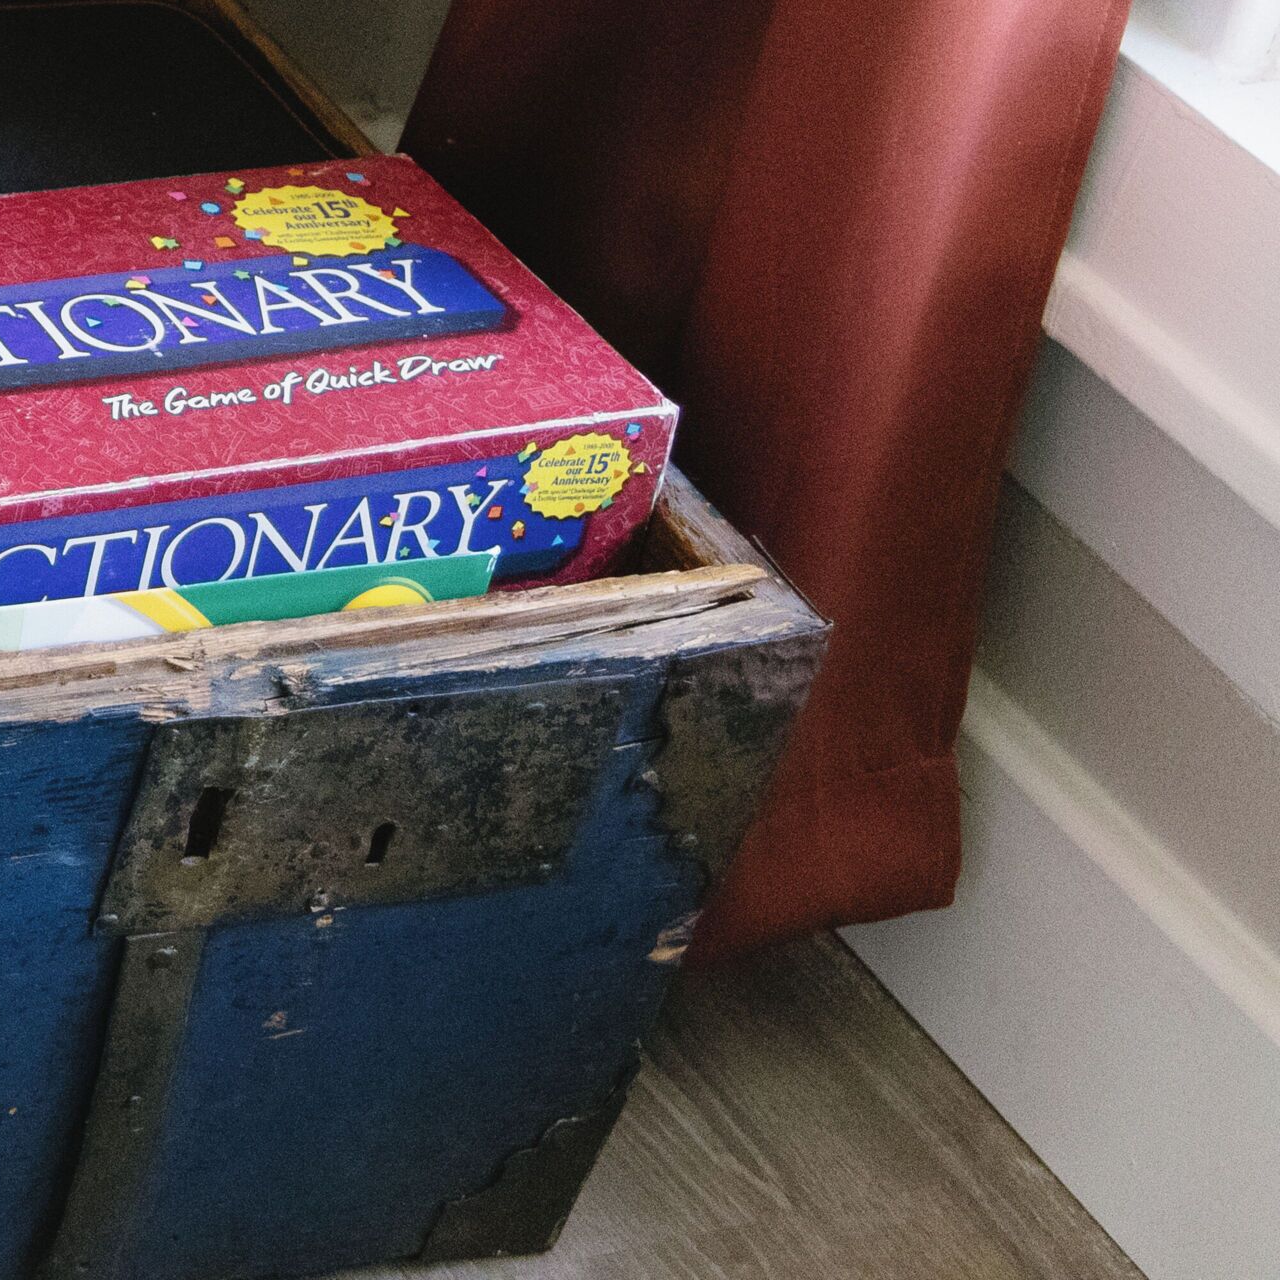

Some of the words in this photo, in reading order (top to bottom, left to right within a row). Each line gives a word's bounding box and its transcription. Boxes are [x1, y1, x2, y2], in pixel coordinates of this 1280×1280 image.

[241, 205, 311, 217] Celebrate
[285, 219, 371, 231] Anniversary
[102, 392, 160, 421] The
[163, 386, 257, 416] Game
[262, 371, 301, 404] of
[305, 363, 398, 396] Quick
[400, 354, 498, 381] Draw
[538, 457, 587, 468] Celebrate
[565, 466, 583, 476] our
[551, 475, 612, 487] Anniversary
